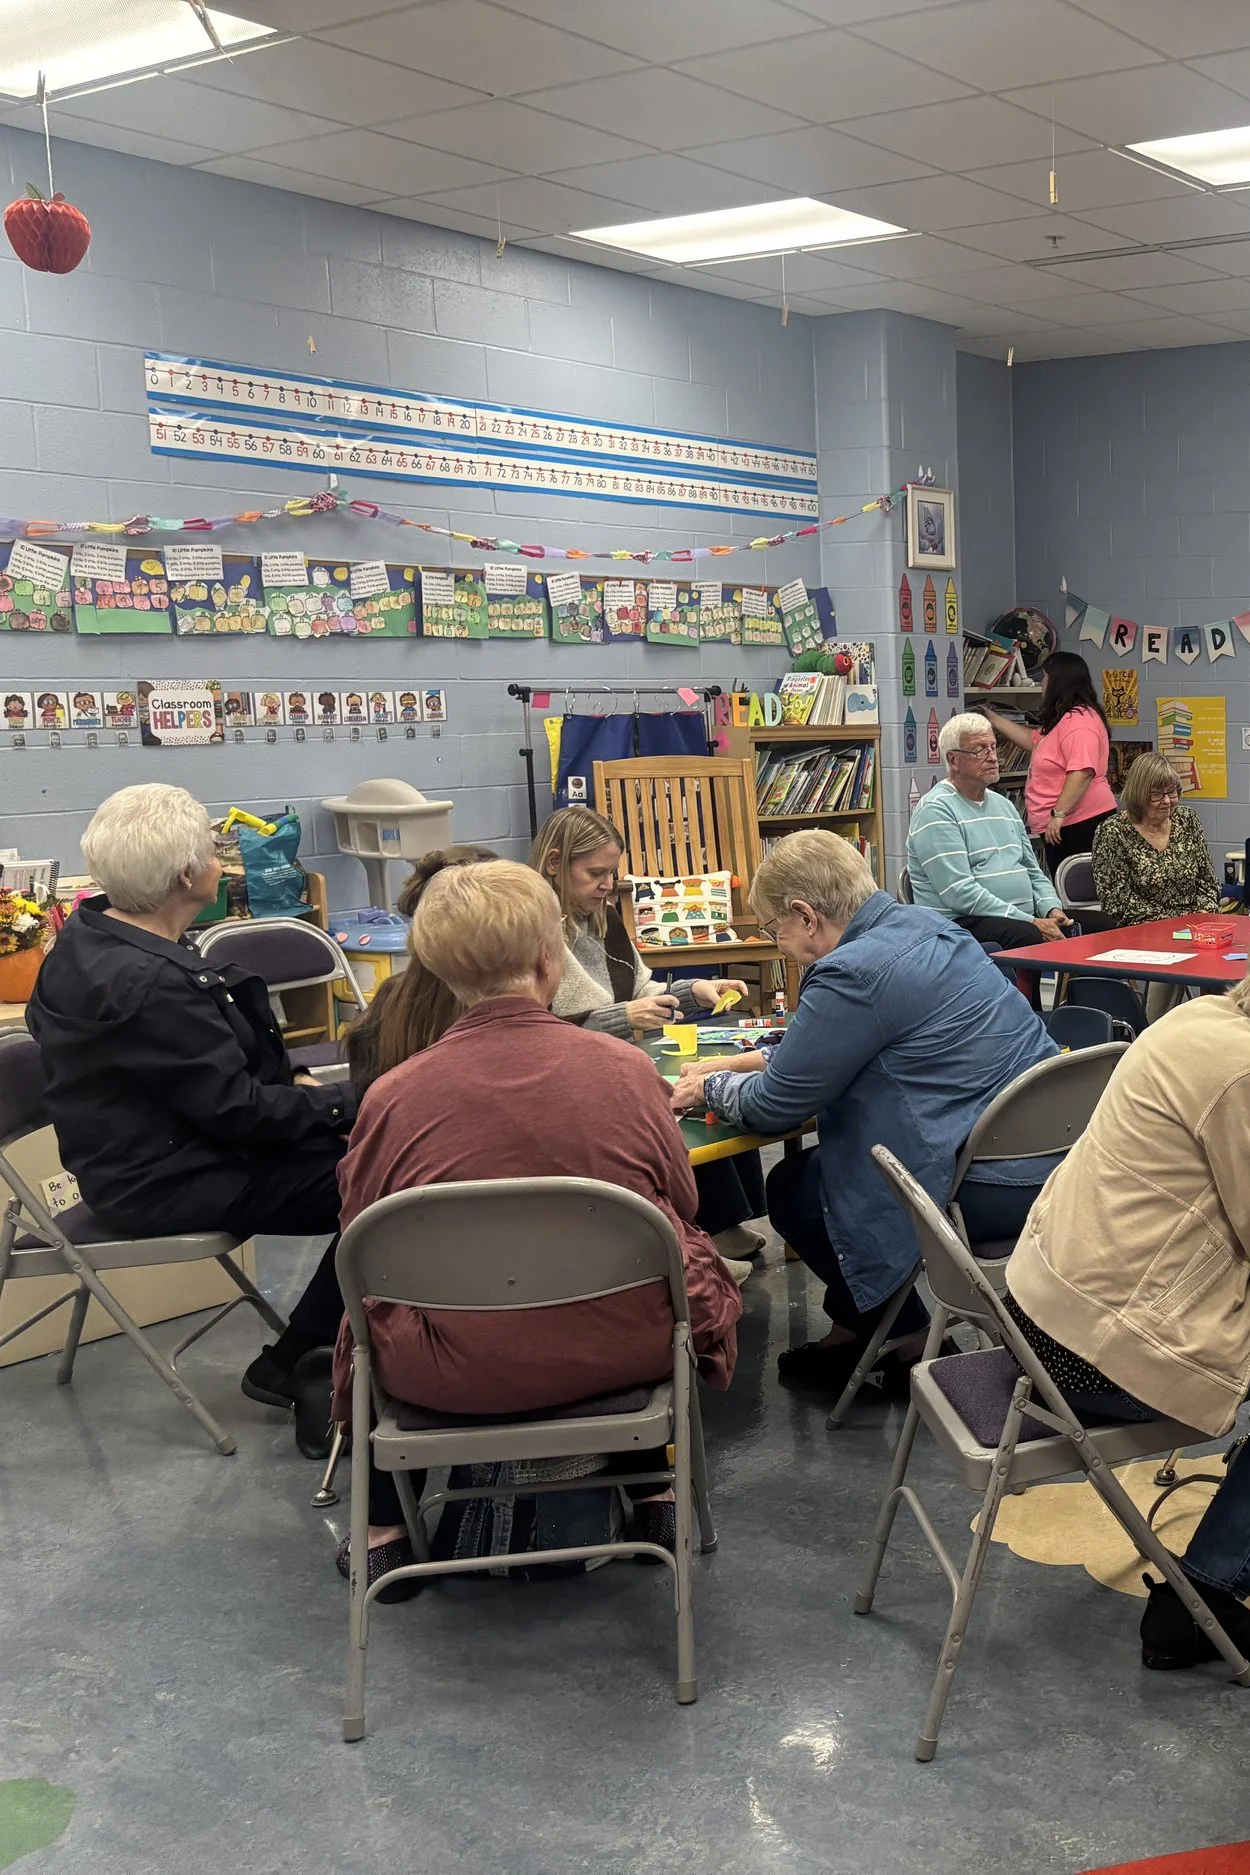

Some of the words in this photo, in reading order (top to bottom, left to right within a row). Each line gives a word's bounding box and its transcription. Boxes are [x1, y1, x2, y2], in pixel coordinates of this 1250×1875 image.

[150, 374, 159, 385] 0
[185, 379, 192, 390] 2
[201, 381, 208, 392] 3
[216, 384, 224, 394] 4
[232, 386, 239, 396] 5
[248, 388, 254, 399] 6
[263, 390, 270, 400] 7
[279, 393, 286, 403] 8
[294, 395, 300, 405] 9
[307, 397, 317, 408] 10
[328, 399, 334, 410] 11
[343, 402, 352, 413] 12
[360, 404, 368, 415] 13
[375, 406, 383, 417] 14
[390, 408, 398, 419] 15
[404, 410, 412, 422] 16
[419, 412, 425, 423] 17
[433, 414, 441, 425] 18
[447, 416, 455, 427] 19
[460, 418, 470, 430] 20
[479, 420, 487, 431] 21
[491, 422, 501, 433] 22
[505, 424, 514, 435] 23
[518, 426, 527, 437] 24
[530, 428, 540, 438] 25
[543, 430, 553, 440] 26
[556, 432, 565, 442] 27
[568, 433, 578, 444] 28
[581, 435, 590, 445] 29
[593, 437, 603, 447] 30
[156, 429, 167, 440] 51
[173, 431, 187, 442] 52
[192, 433, 205, 444] 53
[210, 435, 222, 446] 54
[227, 438, 240, 448] 55
[244, 440, 258, 451] 56
[262, 442, 275, 453] 57
[279, 444, 292, 455] 58
[296, 447, 308, 458] 59
[313, 449, 325, 460] 60
[334, 450, 344, 461] 61
[349, 452, 361, 463] 62
[366, 454, 377, 465] 63
[381, 455, 392, 466] 64
[397, 457, 408, 468] 65
[411, 458, 422, 469] 66
[425, 460, 436, 470] 67
[440, 461, 450, 472] 68
[454, 463, 463, 474] 69
[467, 465, 477, 476] 70
[484, 466, 492, 476] 71
[497, 468, 506, 478] 72
[510, 469, 520, 479] 73
[523, 470, 533, 480] 74
[536, 472, 545, 482] 75
[548, 473, 558, 484] 76
[561, 474, 570, 485] 77
[574, 476, 583, 486] 78
[586, 478, 594, 488] 79
[1114, 624, 1226, 654] READ
[152, 699, 212, 710] Classroom
[715, 692, 782, 727] READ
[153, 710, 213, 730] HELPERS
[49, 1182, 62, 1191] Be
[53, 1198, 66, 1207] to
